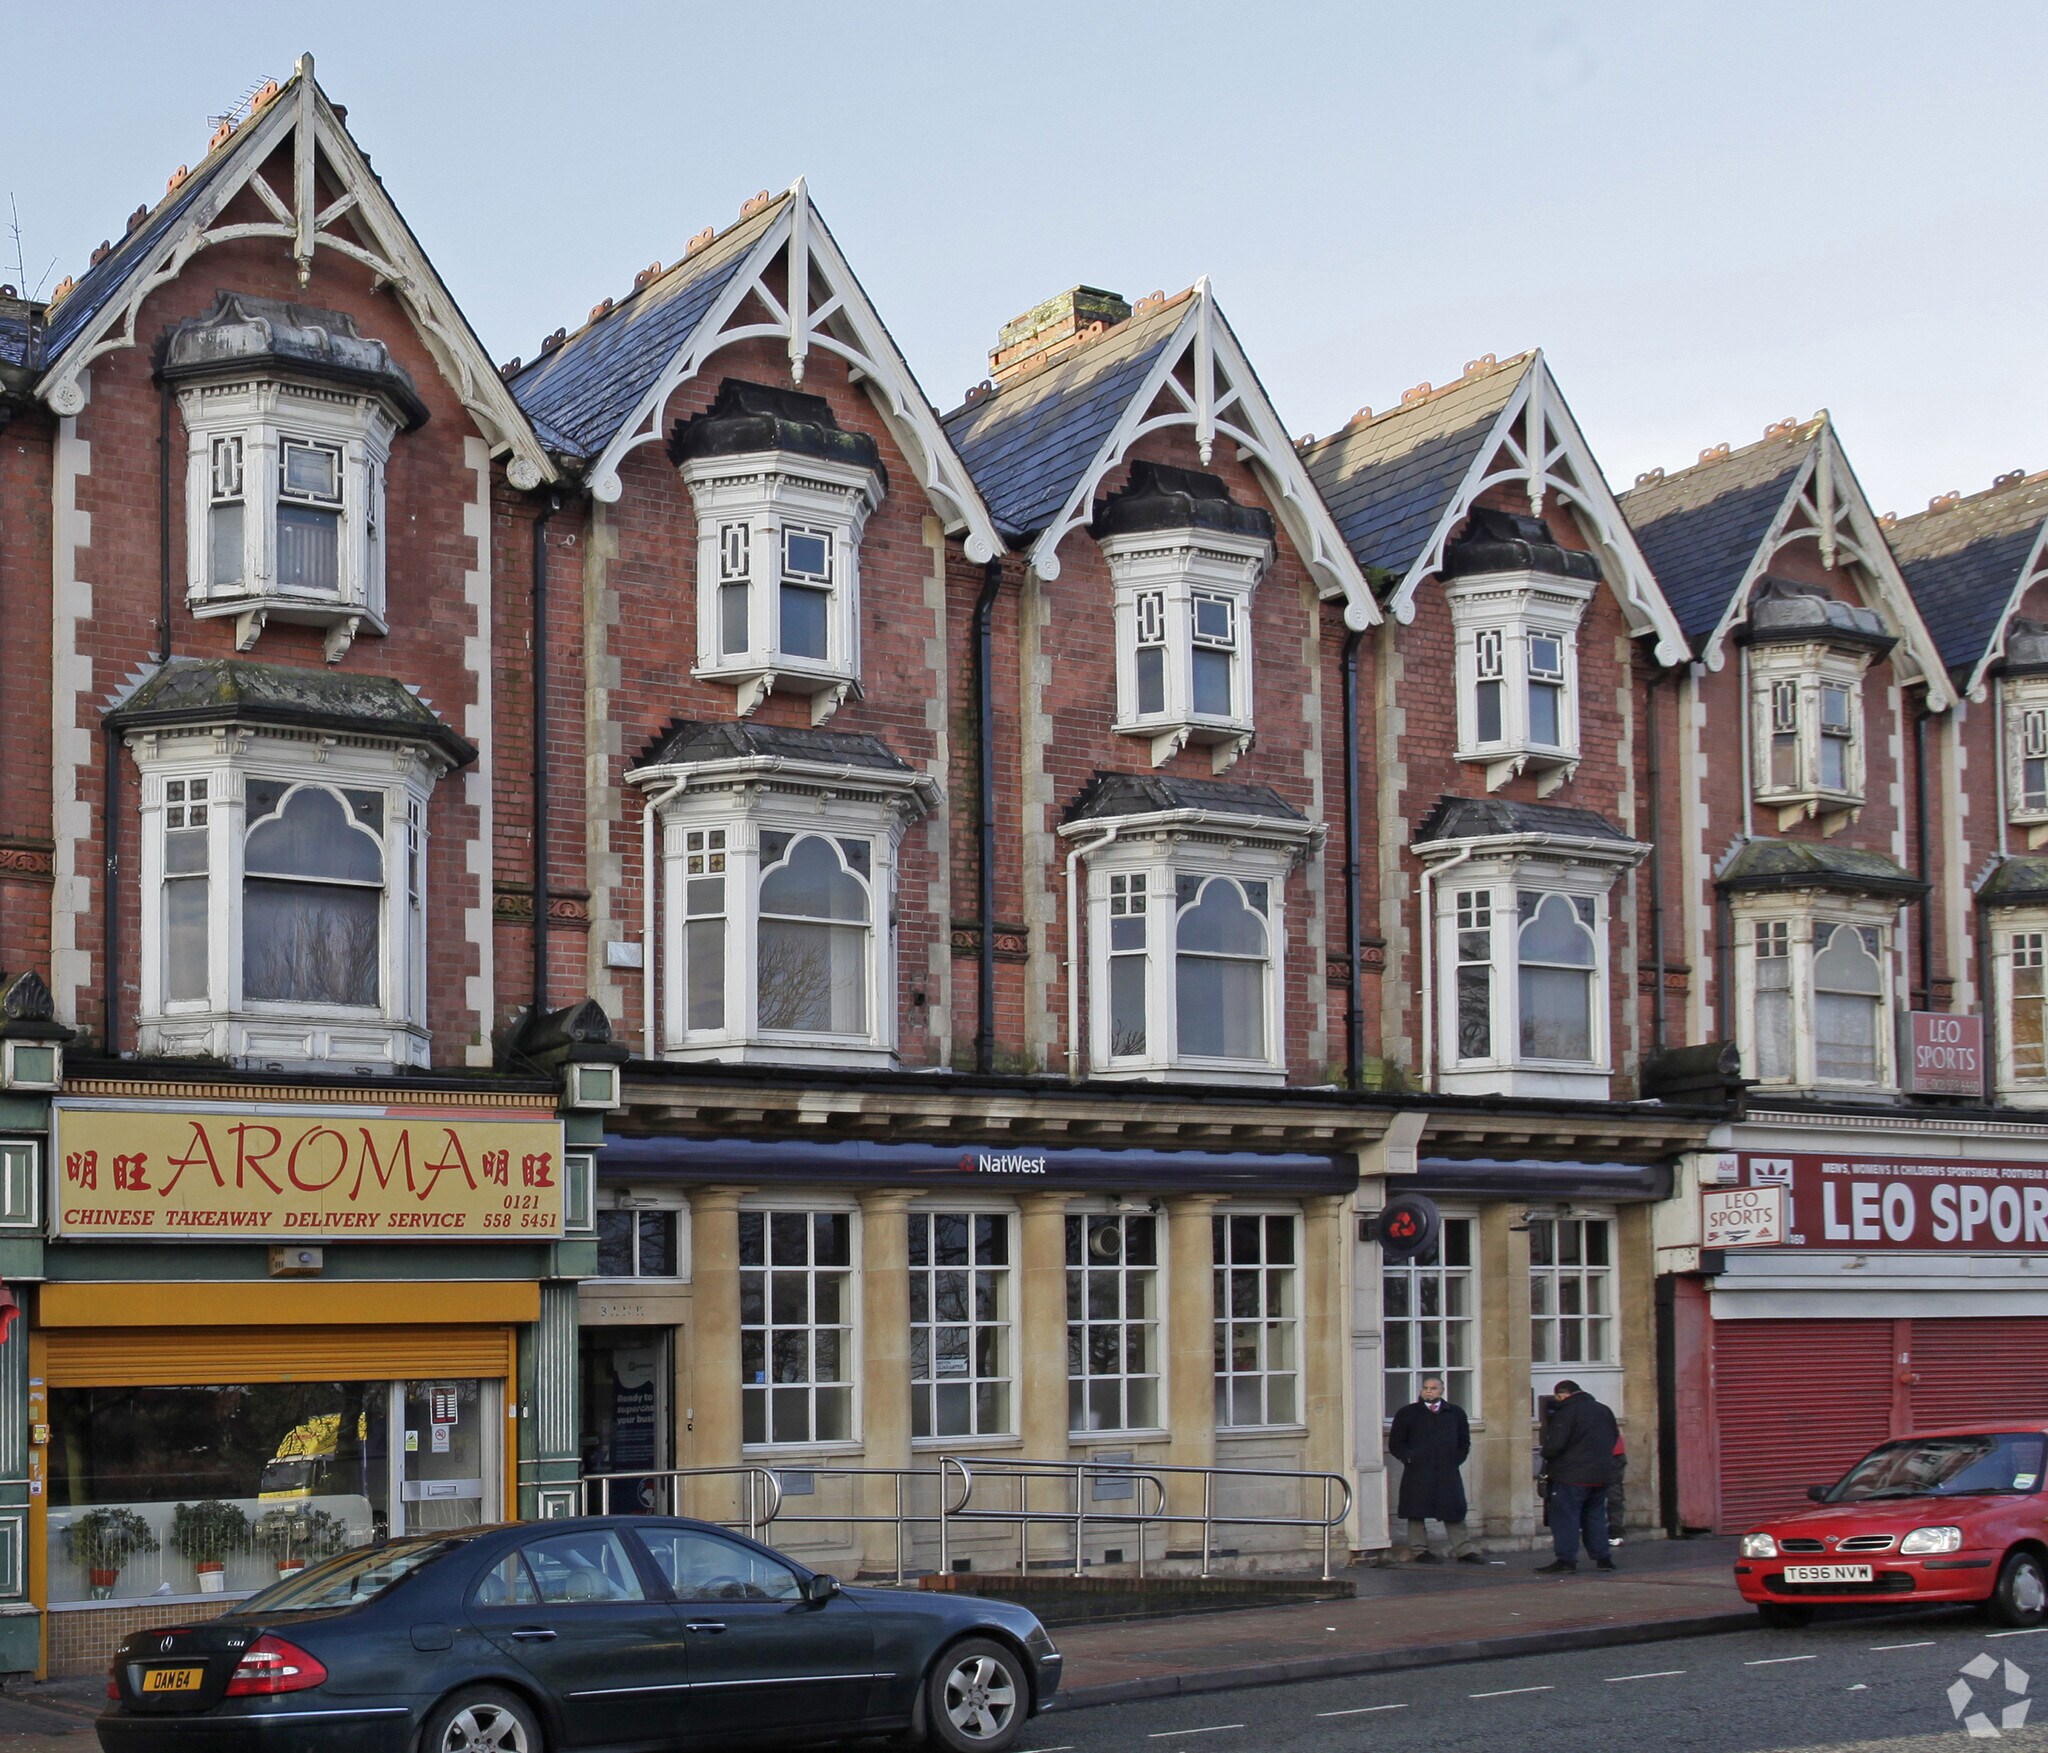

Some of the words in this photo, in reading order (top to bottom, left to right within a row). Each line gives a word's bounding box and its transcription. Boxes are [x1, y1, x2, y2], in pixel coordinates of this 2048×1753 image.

[1929, 1019, 1961, 1043] LEO
[1916, 1045, 1976, 1071] SPORTS
[157, 1121, 478, 1201] AROMA
[979, 1154, 1046, 1174] NatWest
[2001, 1168, 2044, 1179] FOOTWEAR
[503, 1194, 540, 1210] 0121
[1725, 1192, 1758, 1210] LEO
[63, 1208, 155, 1226] CHINESE
[165, 1210, 273, 1228] TAKEAWAY
[283, 1211, 381, 1228] DELIVERY
[388, 1212, 466, 1228] SERVICE
[483, 1212, 511, 1228] 558
[520, 1212, 557, 1228] 5451
[1710, 1207, 1773, 1228] SPORTS
[1822, 1181, 1917, 1242] LEO
[1930, 1183, 2048, 1243] SPOR
[644, 1393, 653, 1402] to
[1787, 1567, 1831, 1580] T696
[1834, 1566, 1869, 1579] NVW
[176, 1670, 192, 1688] 64
